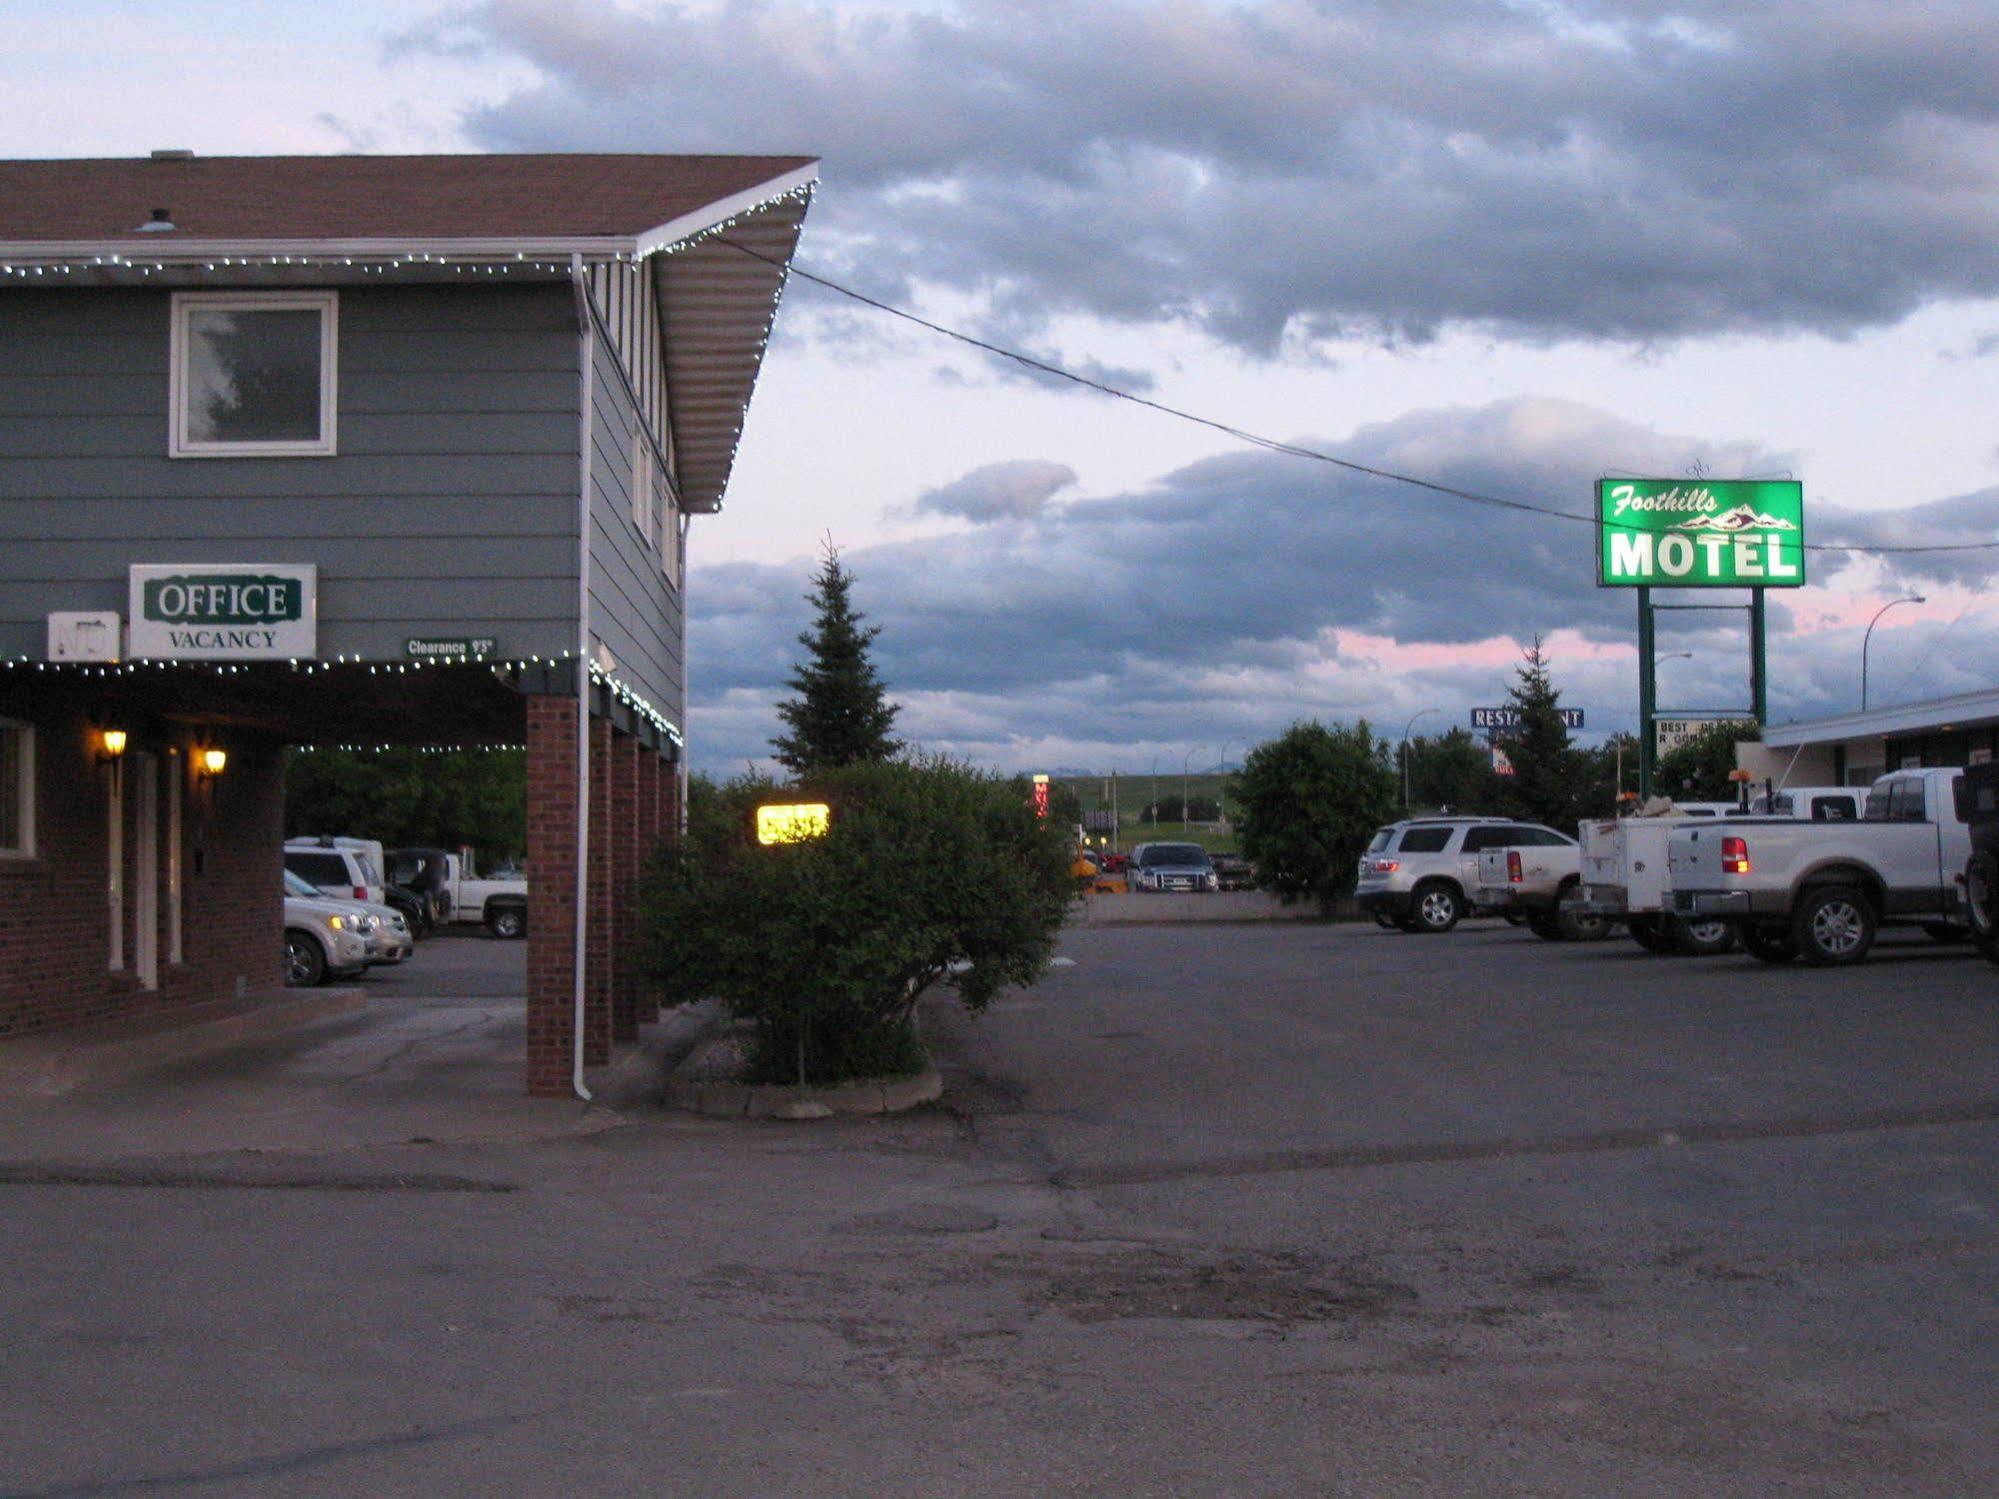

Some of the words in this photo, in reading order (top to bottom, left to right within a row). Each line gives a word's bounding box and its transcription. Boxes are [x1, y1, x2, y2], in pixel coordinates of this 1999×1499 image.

[1611, 485, 1718, 517] Foothills
[1611, 533, 1797, 576] MOTEL
[158, 584, 287, 616] OFFICE
[169, 631, 276, 649] VACANCY
[408, 640, 466, 655] Clearance
[1475, 709, 1580, 727] RESTANT
[1660, 721, 1687, 733] BEST
